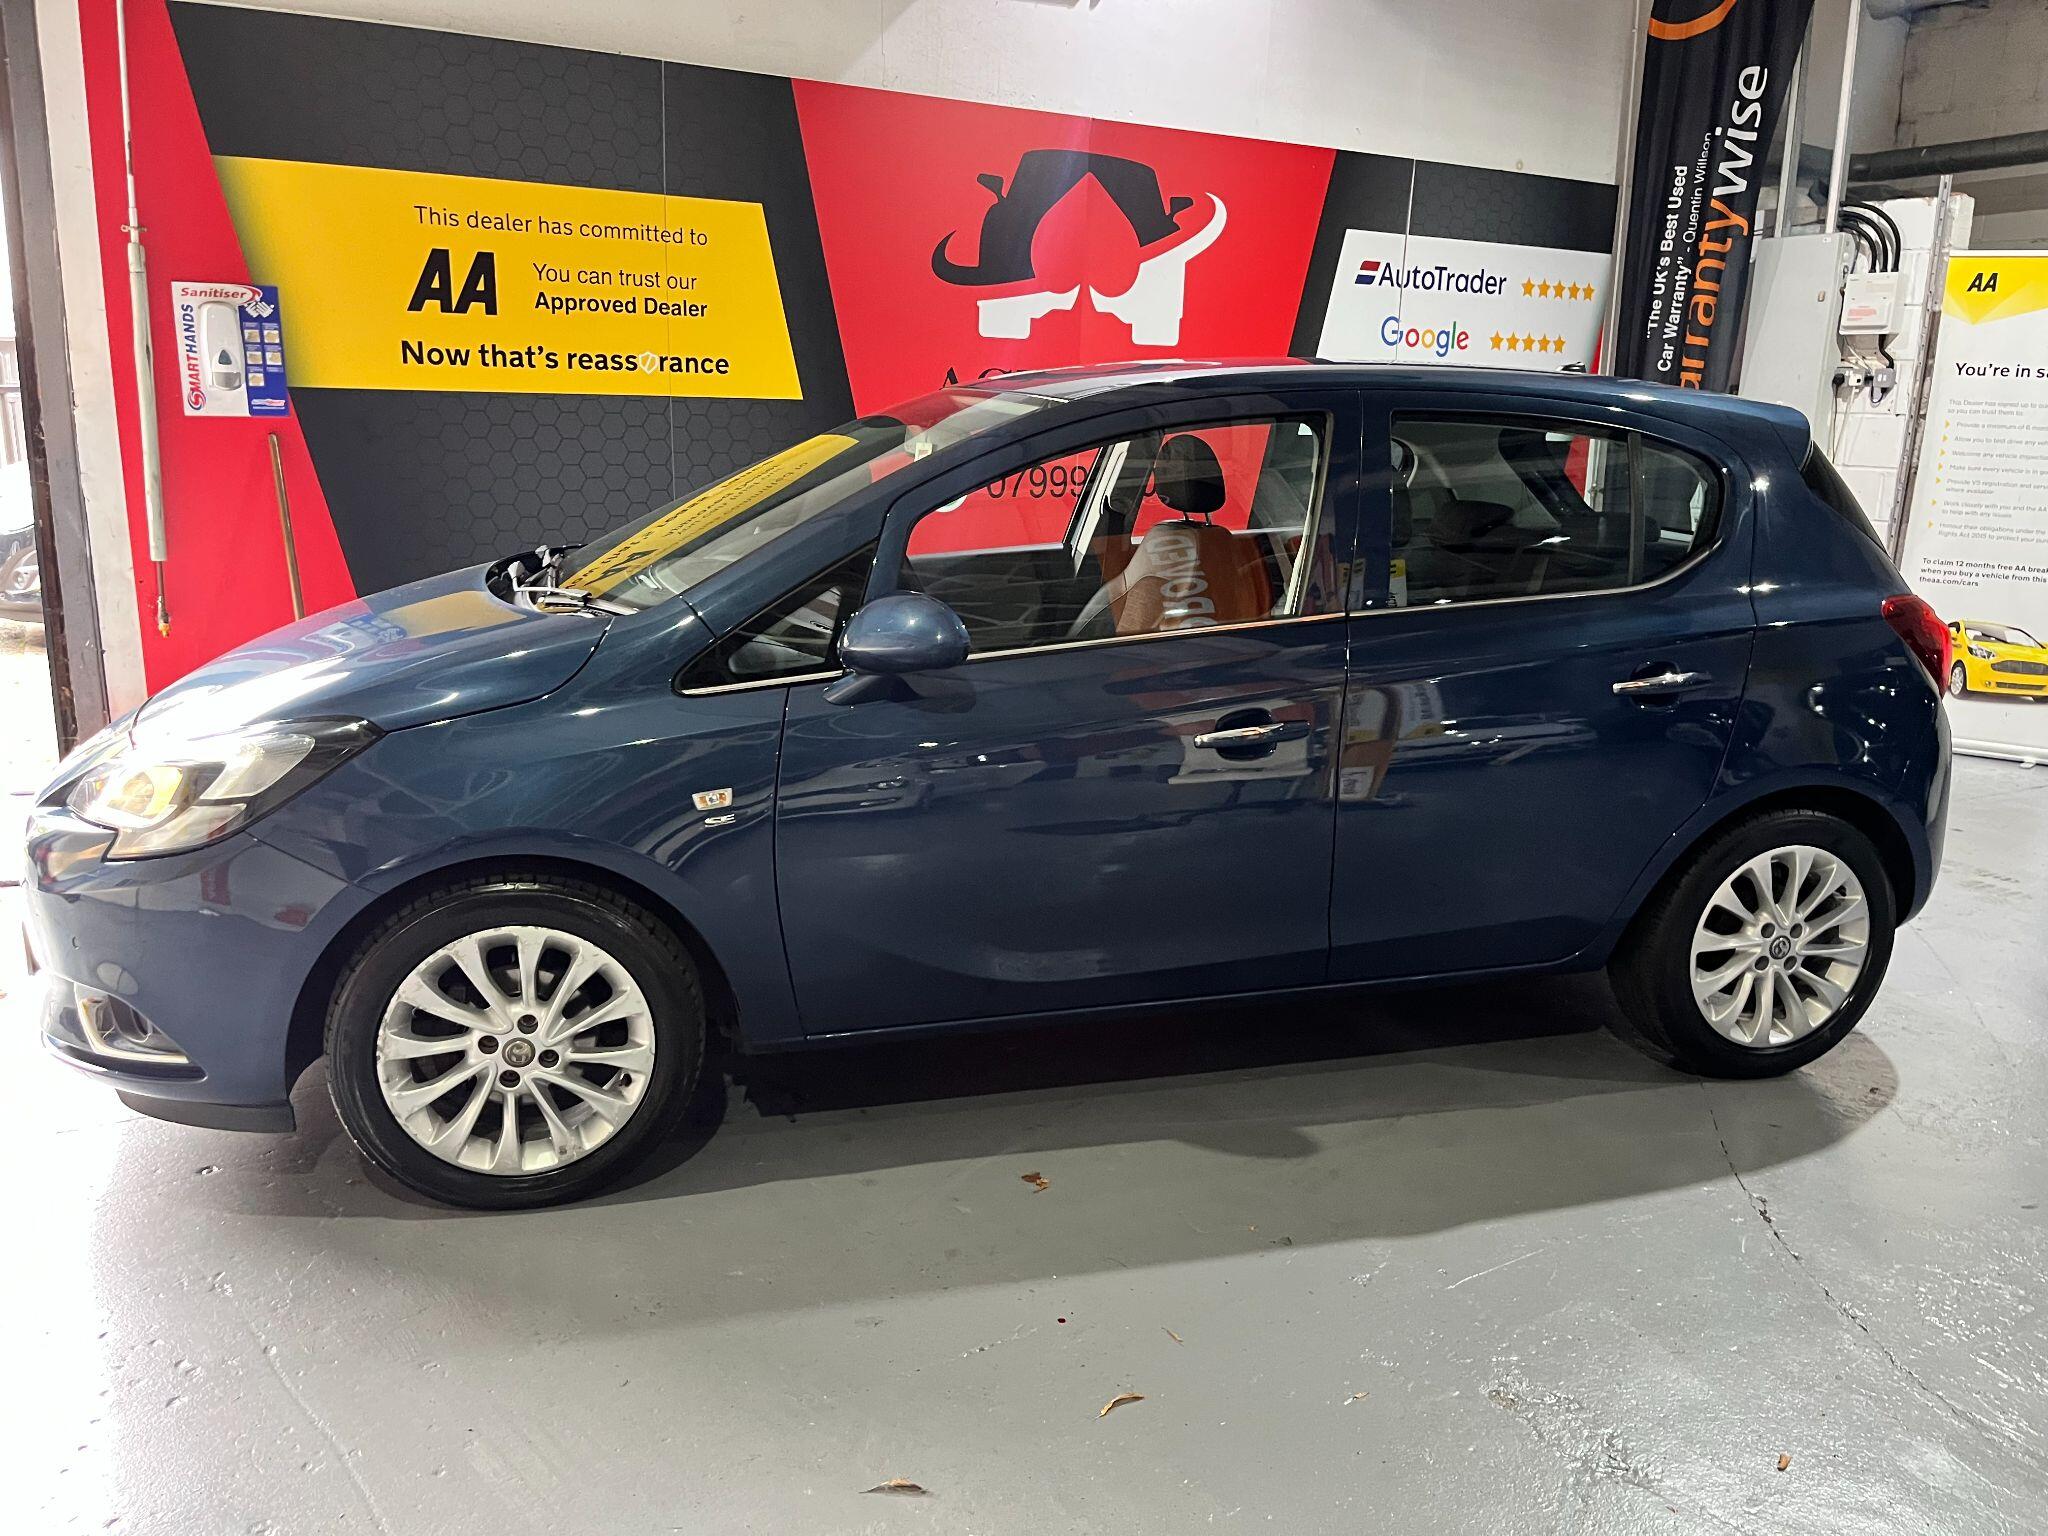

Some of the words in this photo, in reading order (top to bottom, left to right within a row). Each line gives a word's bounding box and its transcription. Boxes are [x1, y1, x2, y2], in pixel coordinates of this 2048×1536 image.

[1667, 166, 1688, 209] Used
[414, 205, 460, 227] This
[466, 211, 532, 233] dealer
[538, 215, 573, 236] has
[579, 222, 684, 245] committed
[690, 228, 708, 246] to
[1661, 213, 1679, 252] Best
[407, 247, 498, 316] AA
[533, 262, 570, 283] You
[577, 266, 612, 286] can
[618, 268, 661, 289] trust
[666, 274, 697, 290] our
[1378, 262, 1507, 295] AutoTrader
[1653, 257, 1671, 295] UK's
[1657, 343, 1676, 372] Car
[1682, 188, 1703, 243] Quentin
[1967, 273, 1998, 292] AA
[181, 287, 247, 299] Sanitiser
[534, 292, 637, 317] Approved
[644, 295, 708, 318] Dealer
[1381, 316, 1470, 357] Google
[401, 340, 470, 366] Now
[478, 343, 559, 369] that's
[1956, 362, 2010, 377] You're
[2015, 364, 2031, 378] in
[2036, 367, 2048, 378] s
[1933, 558, 1953, 566] claim
[1959, 570, 1974, 578] buy
[1981, 572, 2010, 580] vehicle
[2011, 574, 2030, 582] from
